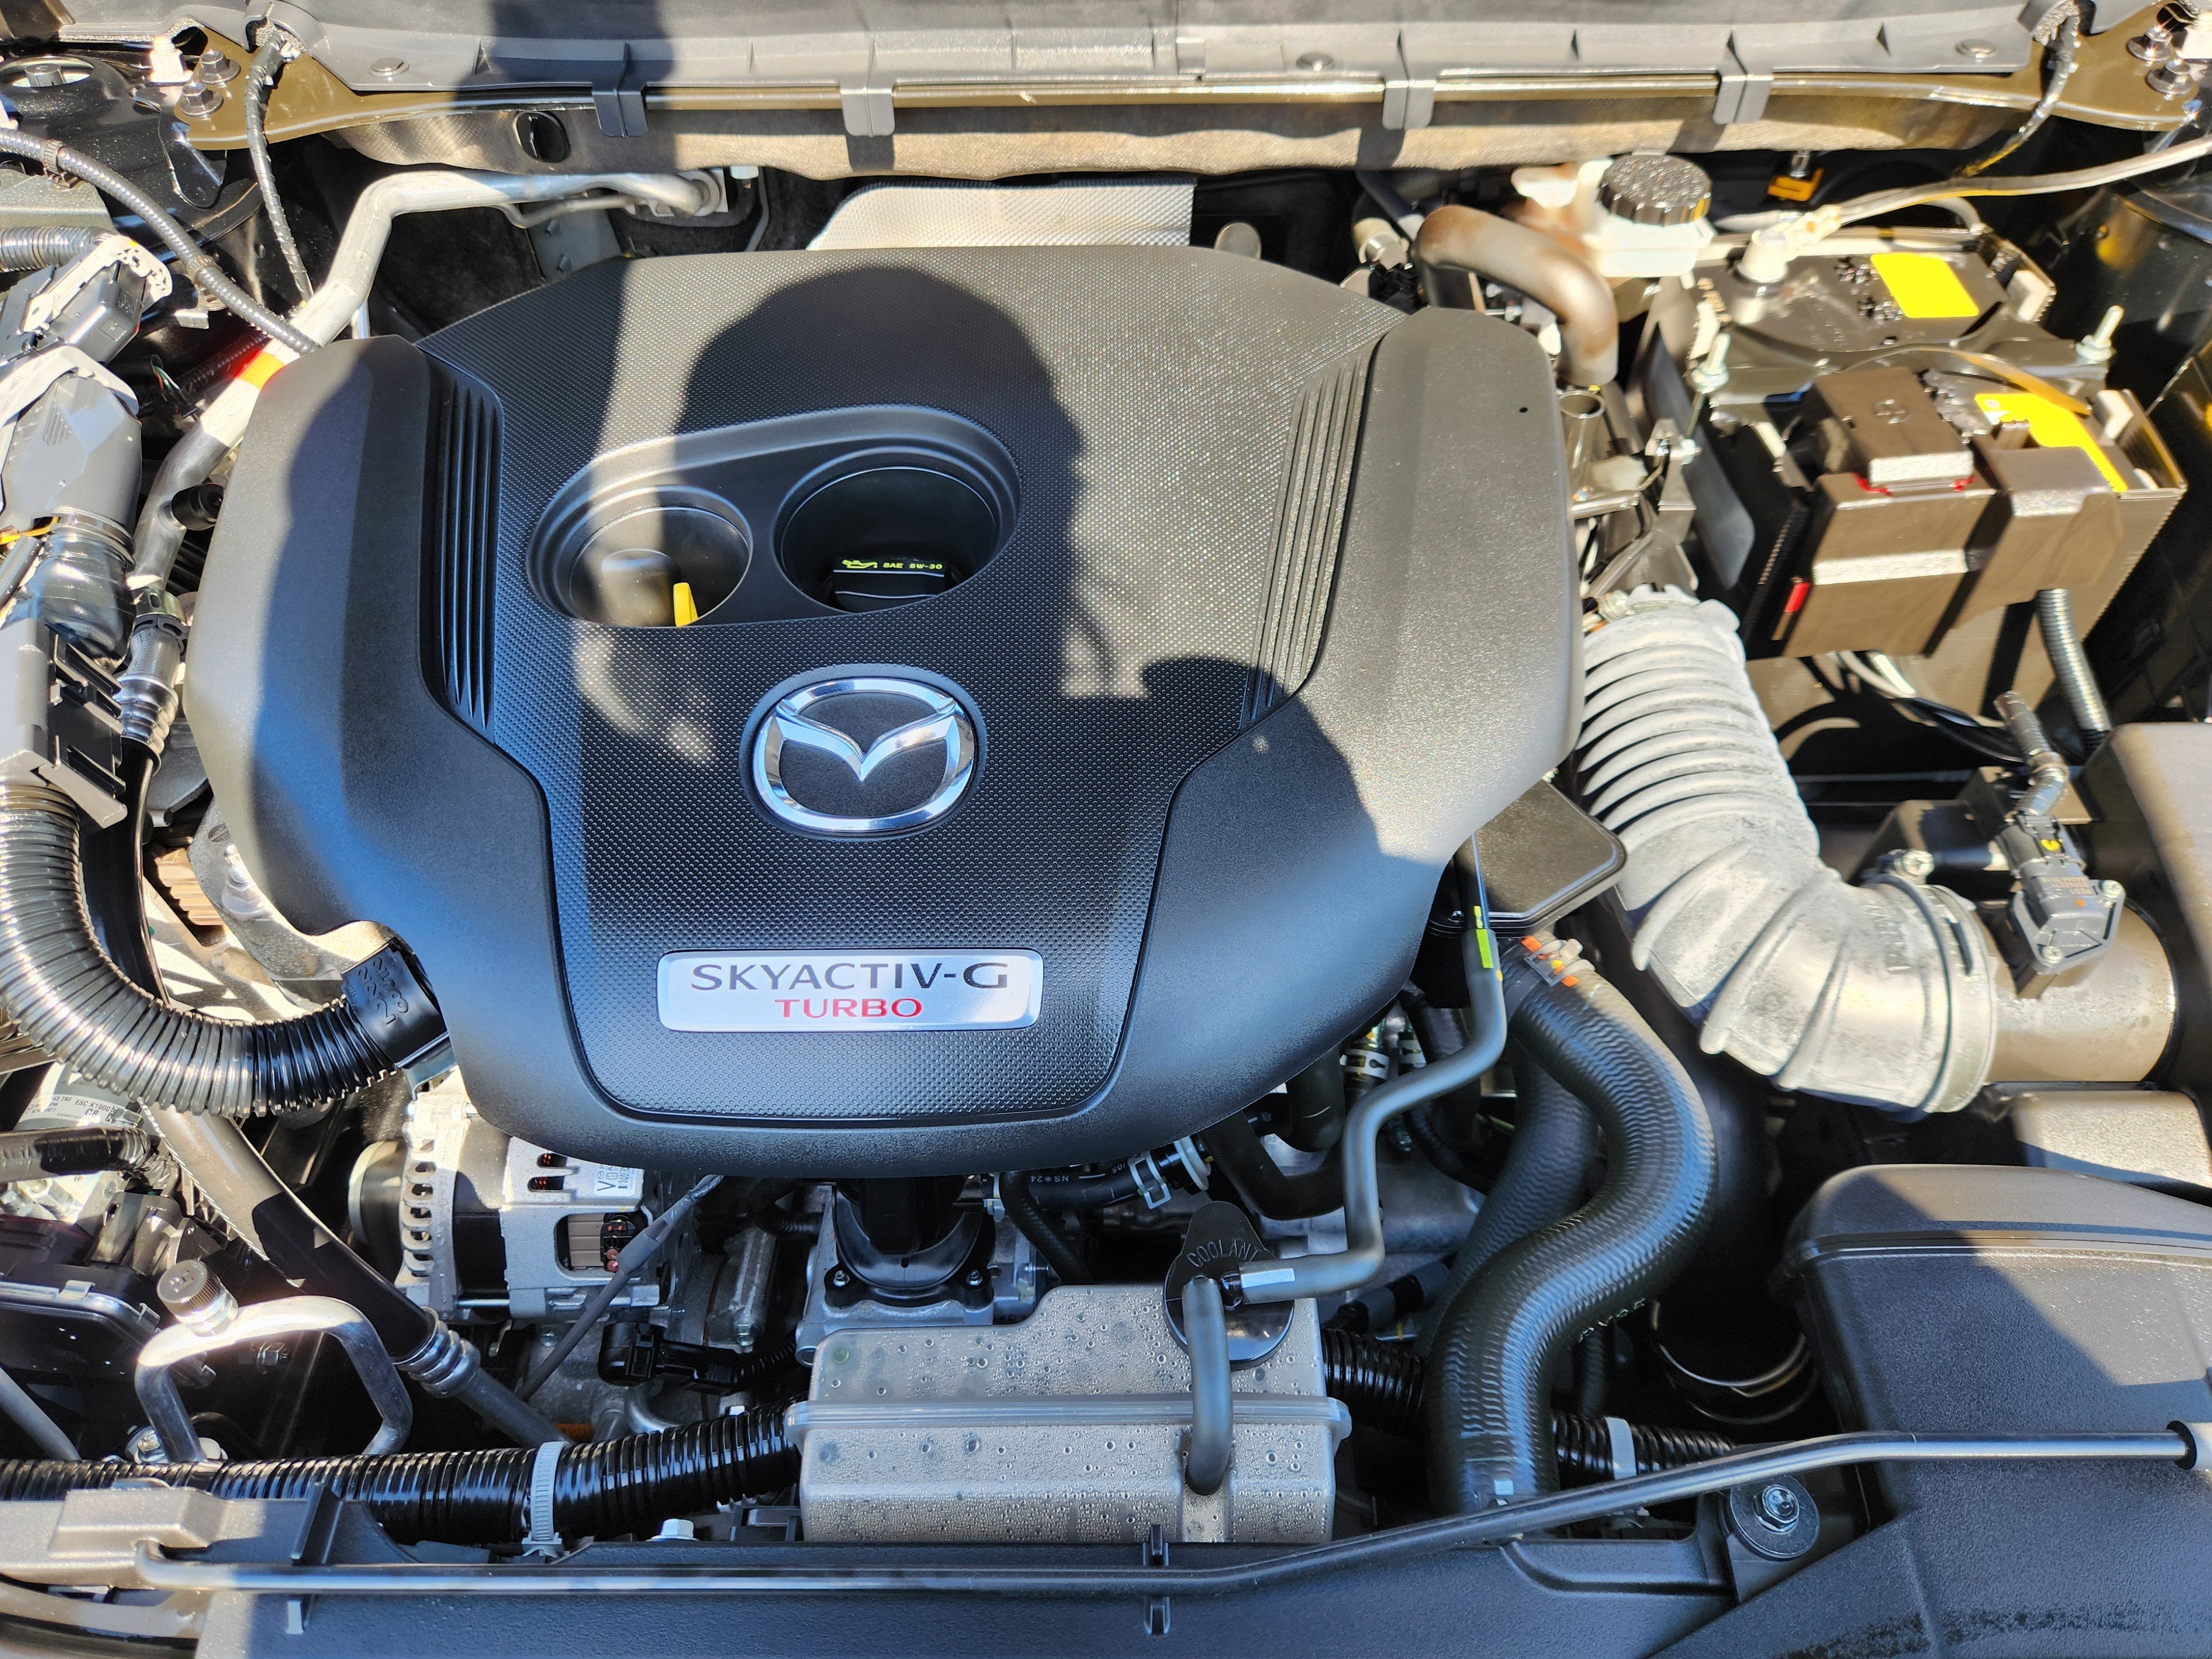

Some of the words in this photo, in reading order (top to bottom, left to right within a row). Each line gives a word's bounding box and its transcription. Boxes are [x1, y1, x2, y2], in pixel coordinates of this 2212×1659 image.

[691, 963, 1008, 990] SKYACTIV-G
[774, 998, 923, 1018] TURBO
[597, 1180, 616, 1191] V
[1187, 1238, 1262, 1267] COOLANT
